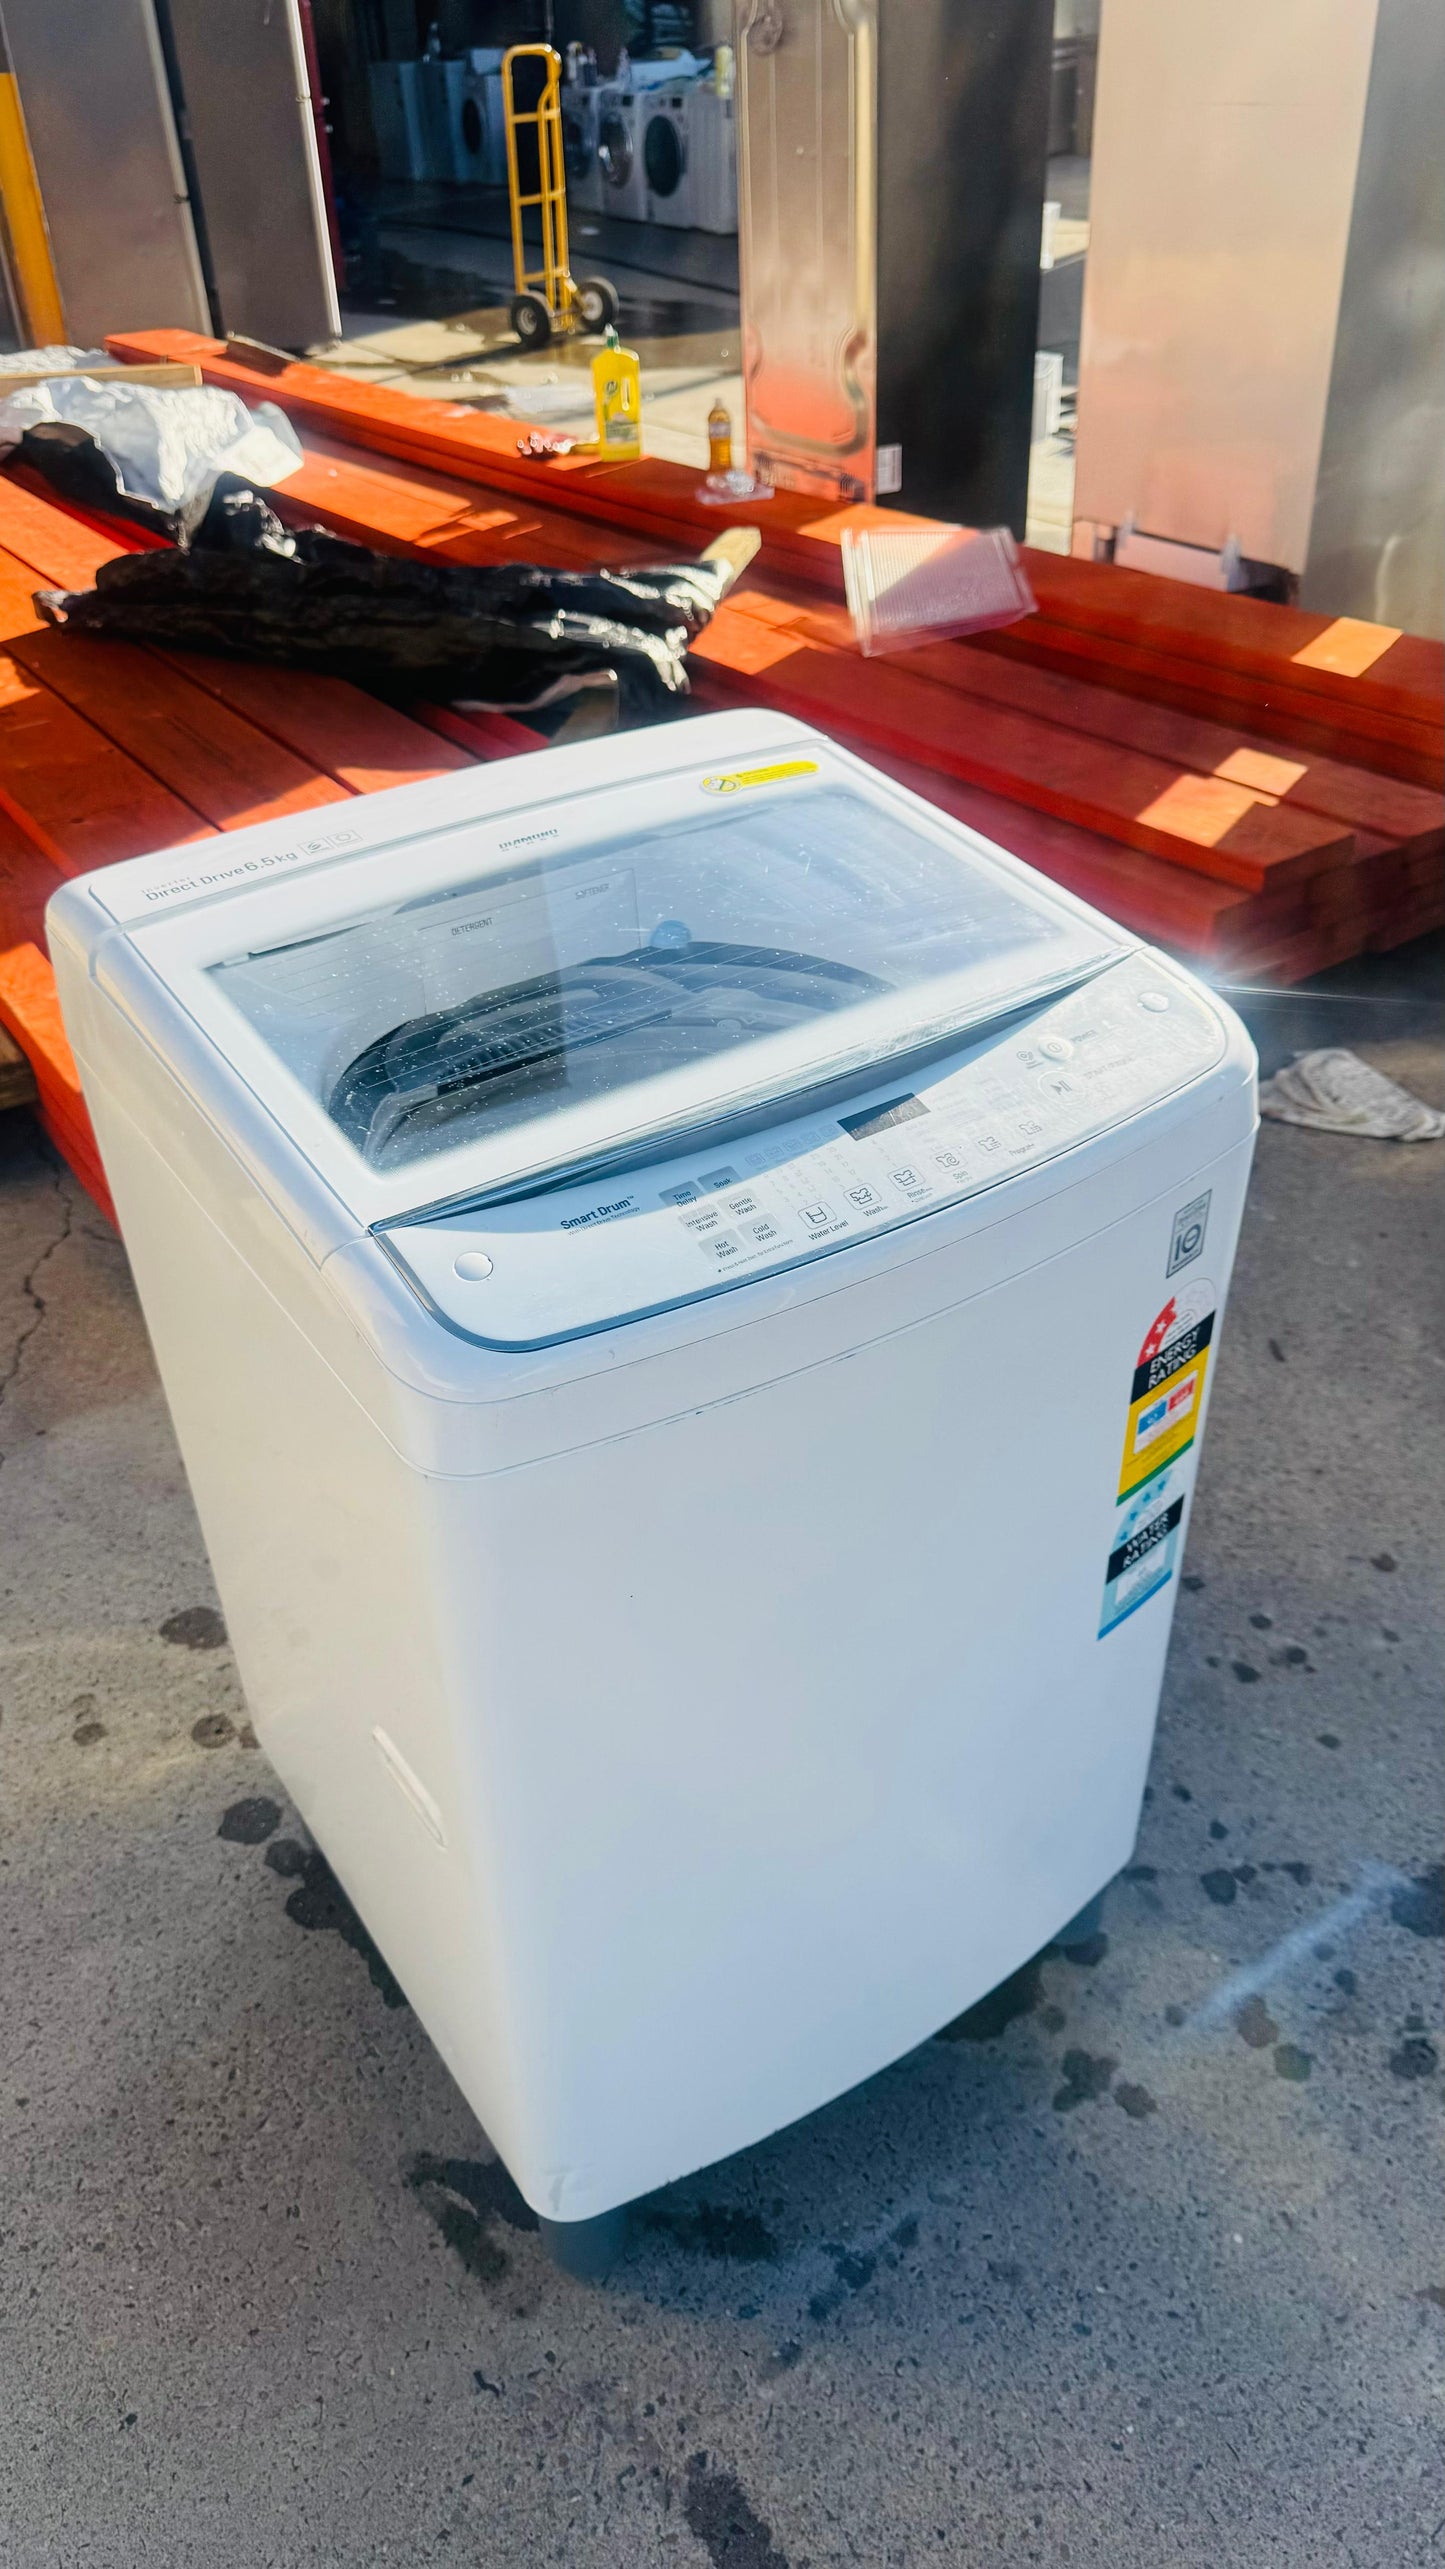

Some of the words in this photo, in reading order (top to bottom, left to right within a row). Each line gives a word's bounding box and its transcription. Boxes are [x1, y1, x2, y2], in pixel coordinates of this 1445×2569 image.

[145, 880, 199, 901] Direct
[199, 866, 245, 887] Drive
[450, 917, 493, 936] DETERGENT
[713, 1177, 732, 1189] Soak
[672, 1190, 692, 1201] Time
[676, 1196, 698, 1208] Delay
[728, 1197, 753, 1211] Gentle
[735, 1203, 757, 1216] Wash
[685, 1210, 719, 1228] Intensive
[863, 1206, 884, 1218] Wash
[560, 1211, 599, 1230] Smart
[695, 1219, 719, 1232] Wash
[752, 1223, 770, 1234] Cold
[755, 1229, 778, 1242] Wash
[808, 1228, 830, 1241] Water
[830, 1220, 849, 1233] Level
[714, 1240, 730, 1251] Hot
[716, 1245, 739, 1259] Wash
[1149, 1326, 1200, 1374] ENERGY
[1147, 1343, 1197, 1389] RATING
[1126, 1512, 1169, 1553] WATER
[1122, 1526, 1168, 1568] RATING
